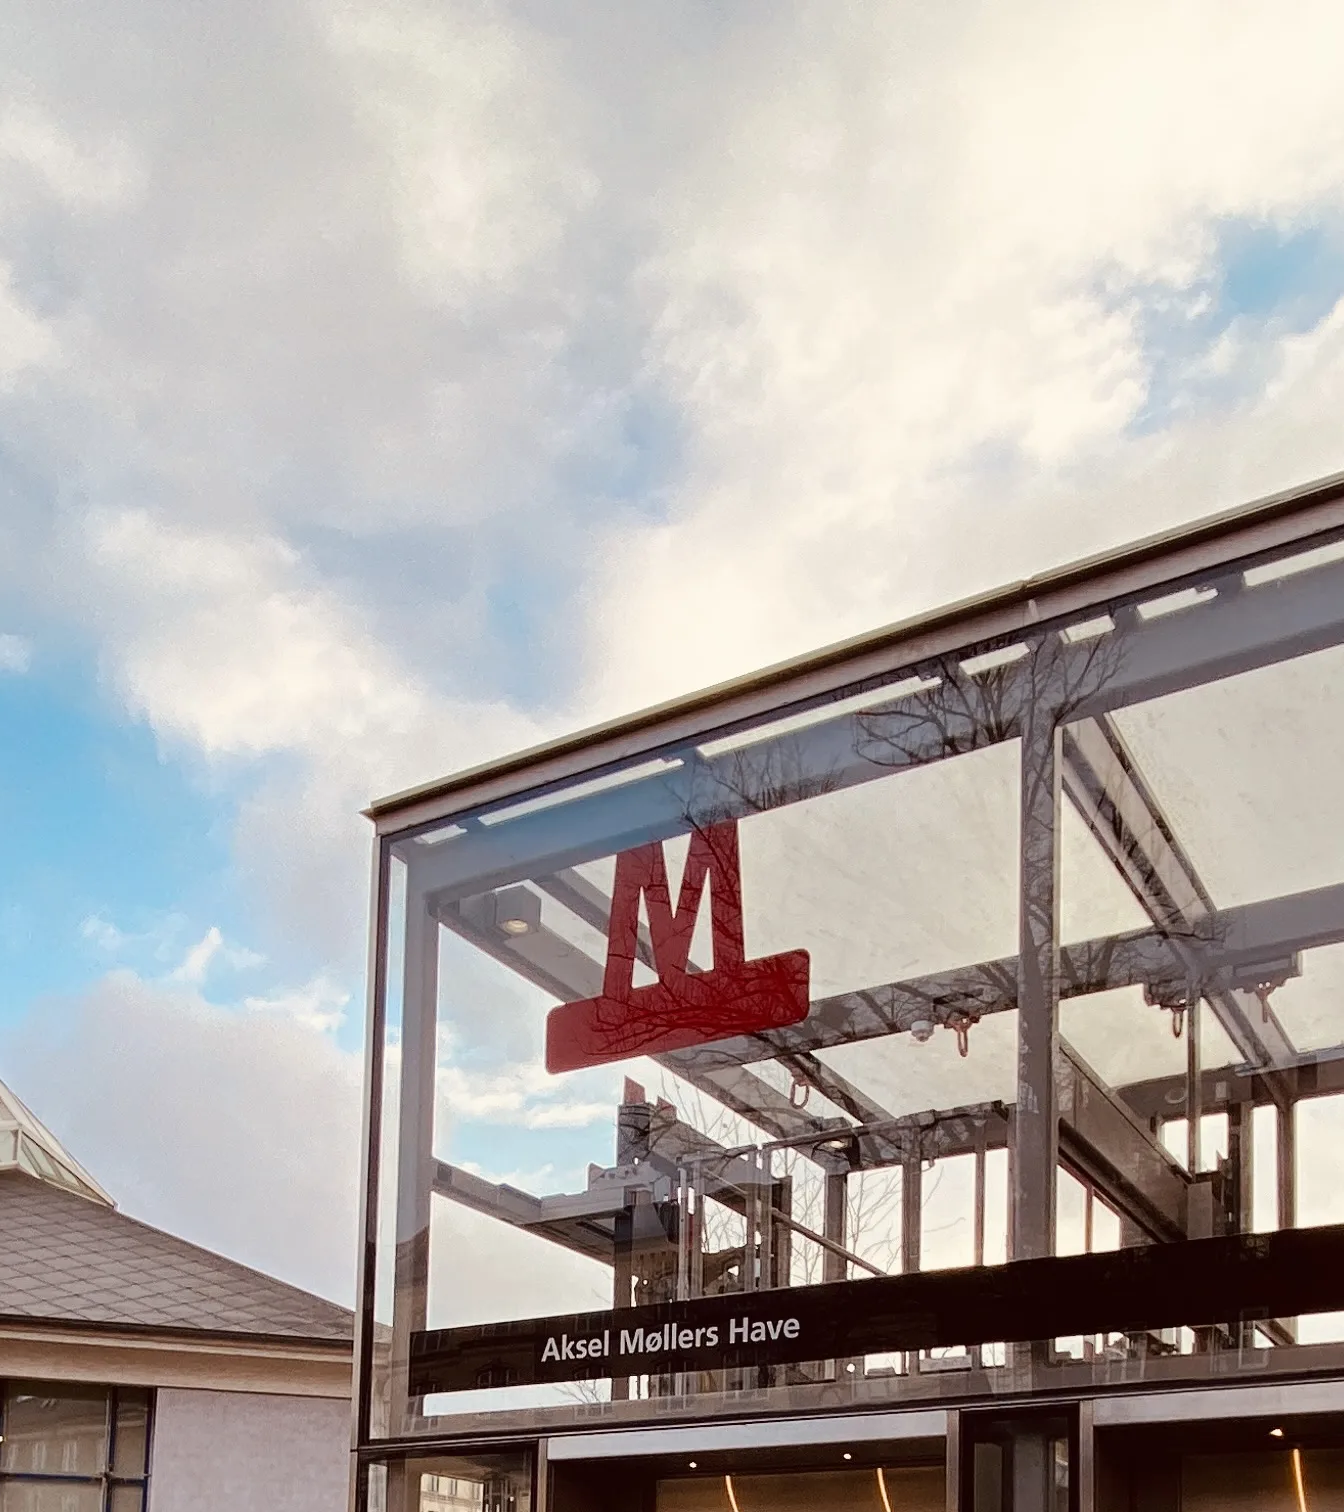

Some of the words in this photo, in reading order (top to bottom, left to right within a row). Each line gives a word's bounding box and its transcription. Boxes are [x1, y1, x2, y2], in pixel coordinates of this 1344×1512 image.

[541, 1330, 609, 1362] Aksel
[619, 1323, 718, 1355] Møllers
[729, 1316, 800, 1344] Have
